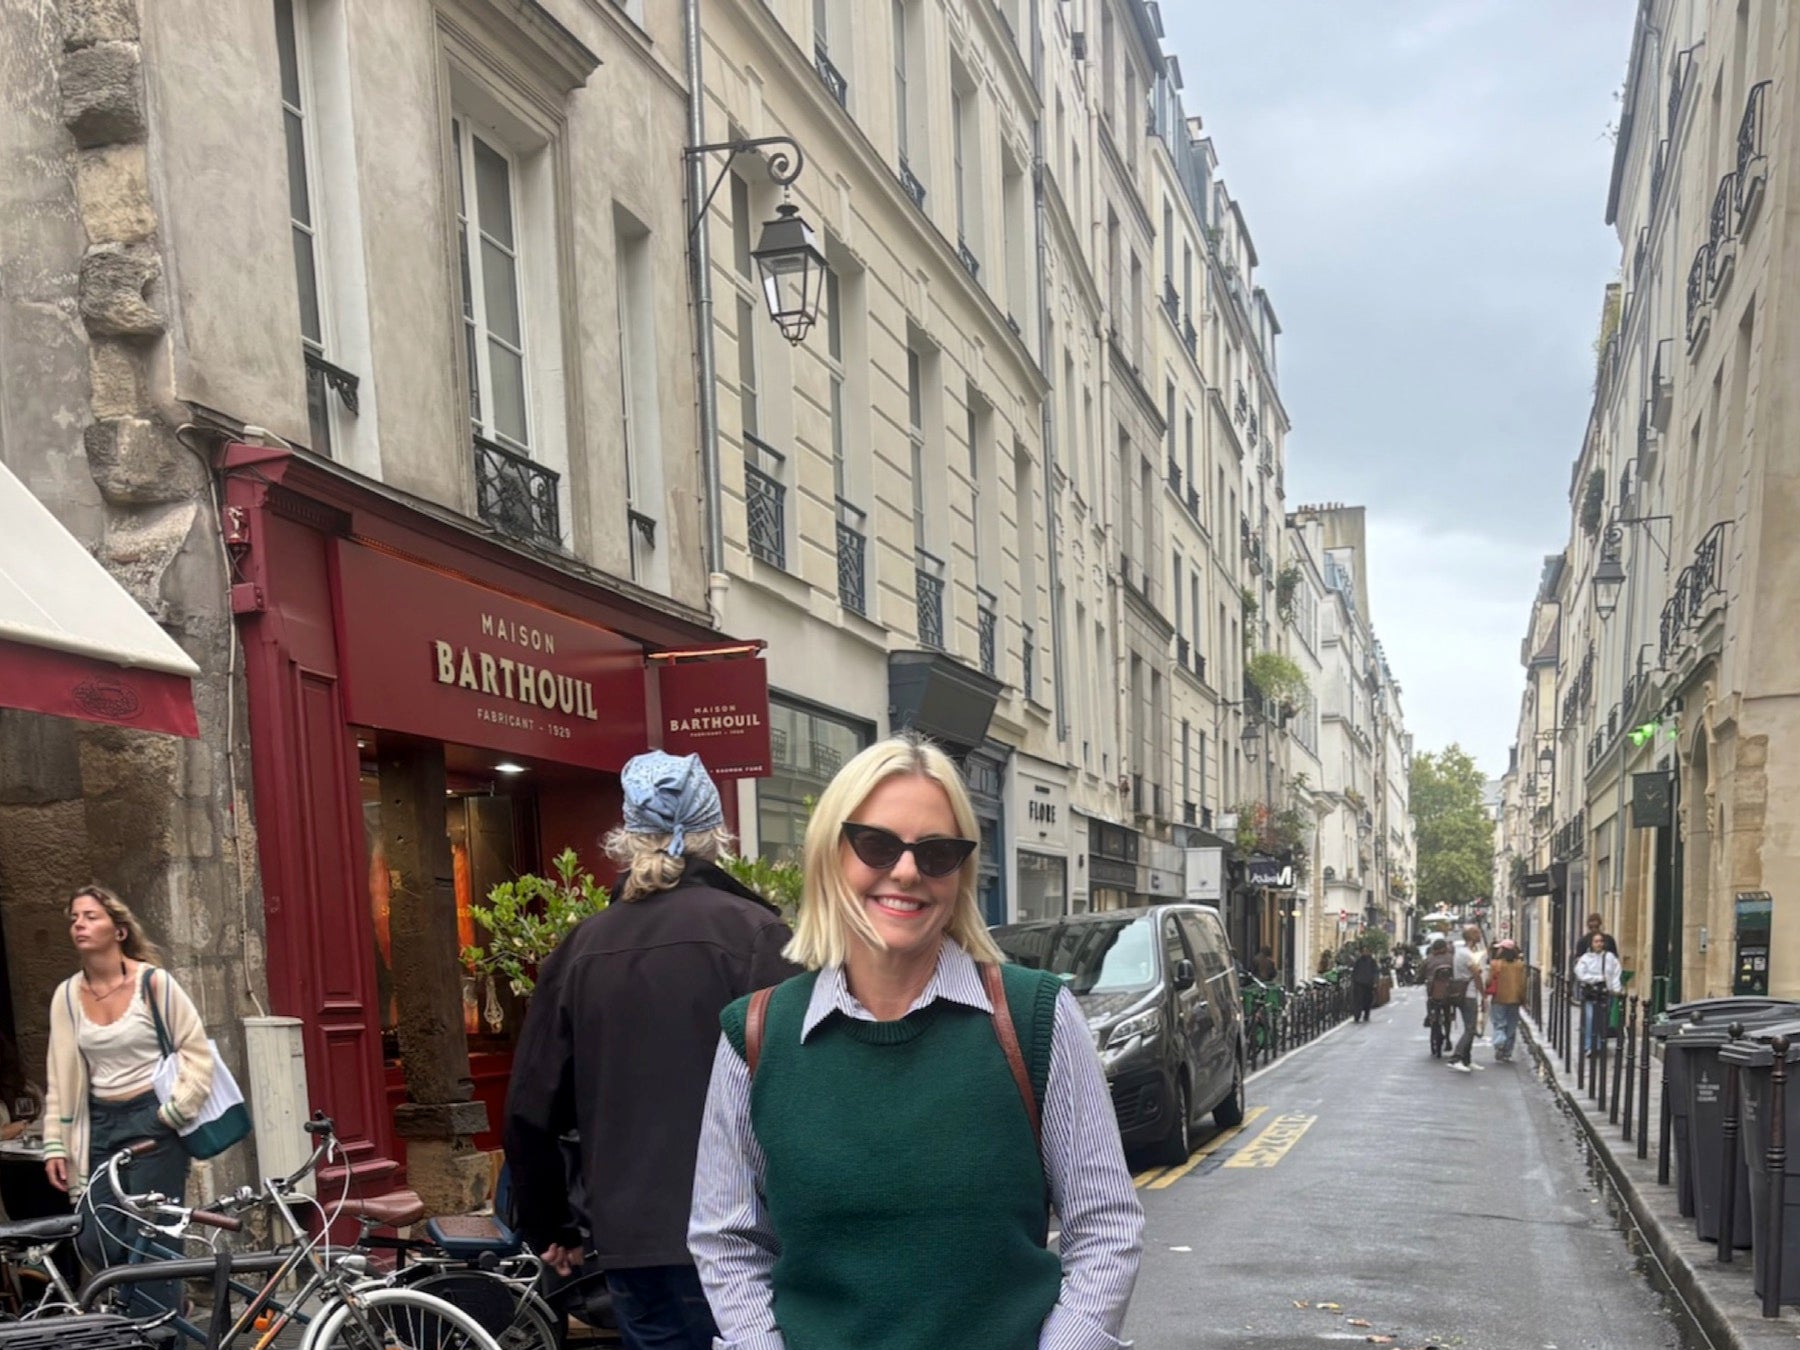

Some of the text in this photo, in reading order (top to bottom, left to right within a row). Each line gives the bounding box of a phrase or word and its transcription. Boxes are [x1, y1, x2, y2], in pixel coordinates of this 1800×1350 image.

[481, 613, 555, 655] MAISON
[435, 639, 598, 720] BARTHOUIL
[477, 708, 535, 730] FABRICANT
[548, 723, 571, 739] 1929
[670, 714, 760, 732] BARTHOUIL
[694, 704, 737, 714] MAISON
